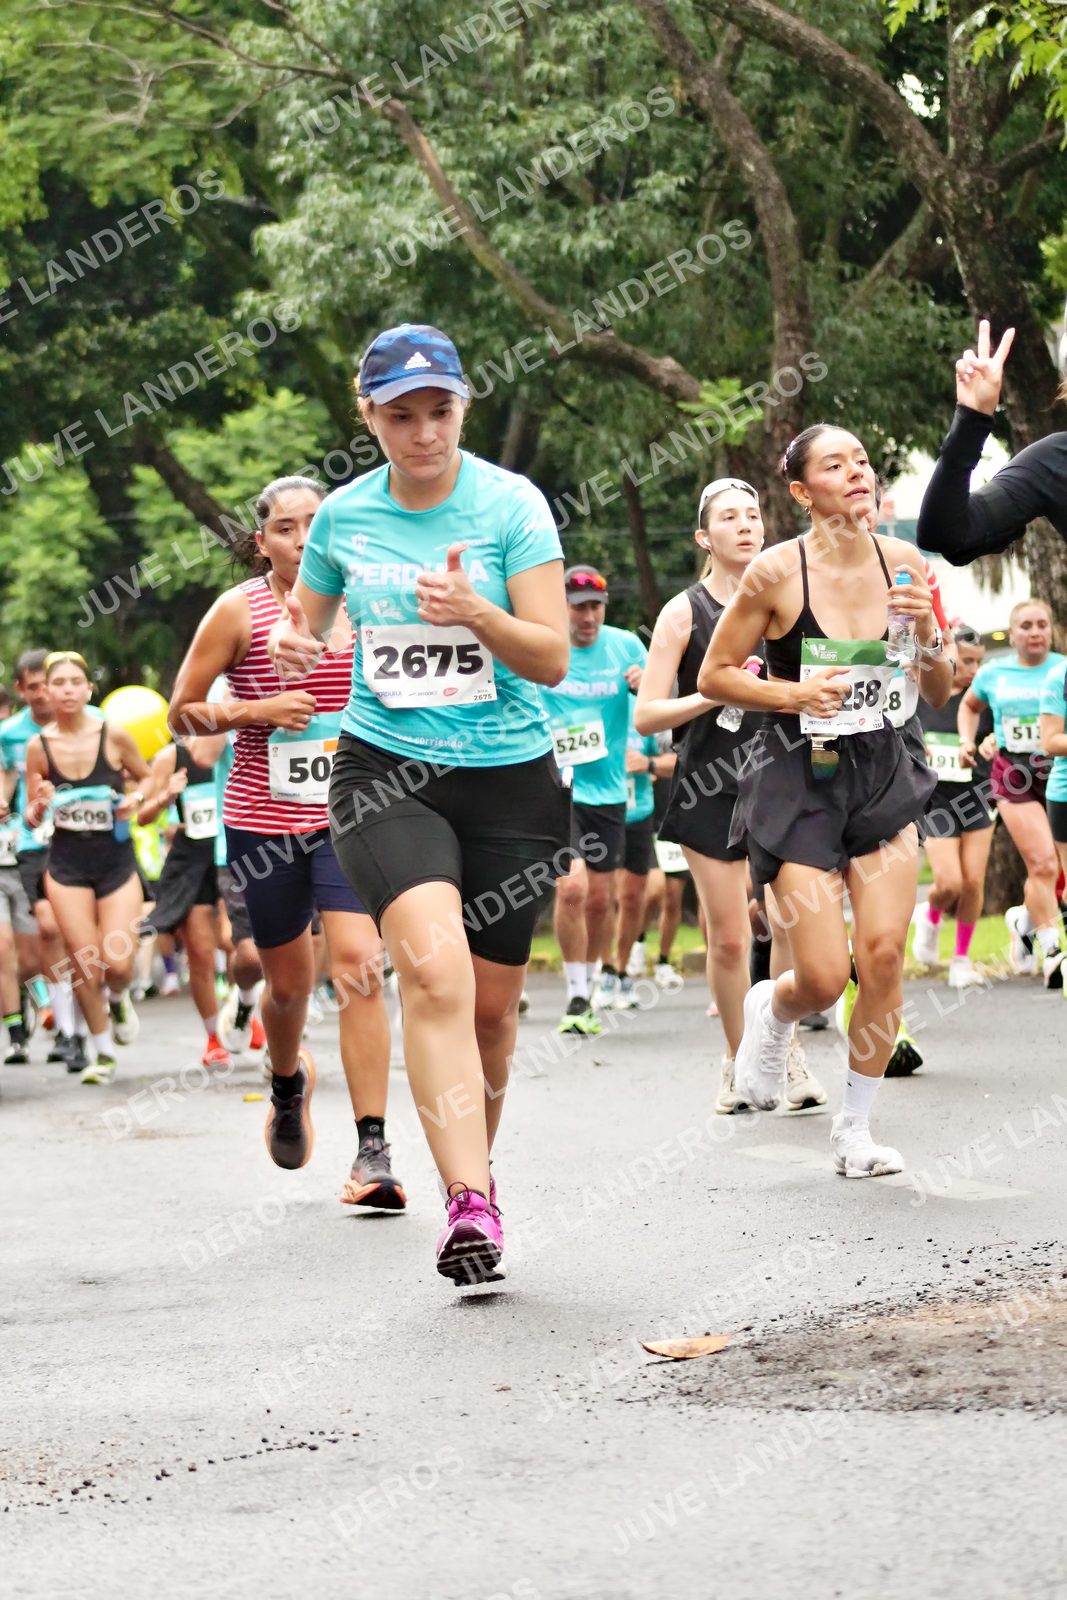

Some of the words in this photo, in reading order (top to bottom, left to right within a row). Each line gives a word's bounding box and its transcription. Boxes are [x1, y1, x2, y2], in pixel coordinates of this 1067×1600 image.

[348, 559, 490, 586] PERDA
[373, 643, 484, 679] 2675
[556, 732, 600, 754] 5249
[288, 756, 335, 784] 50
